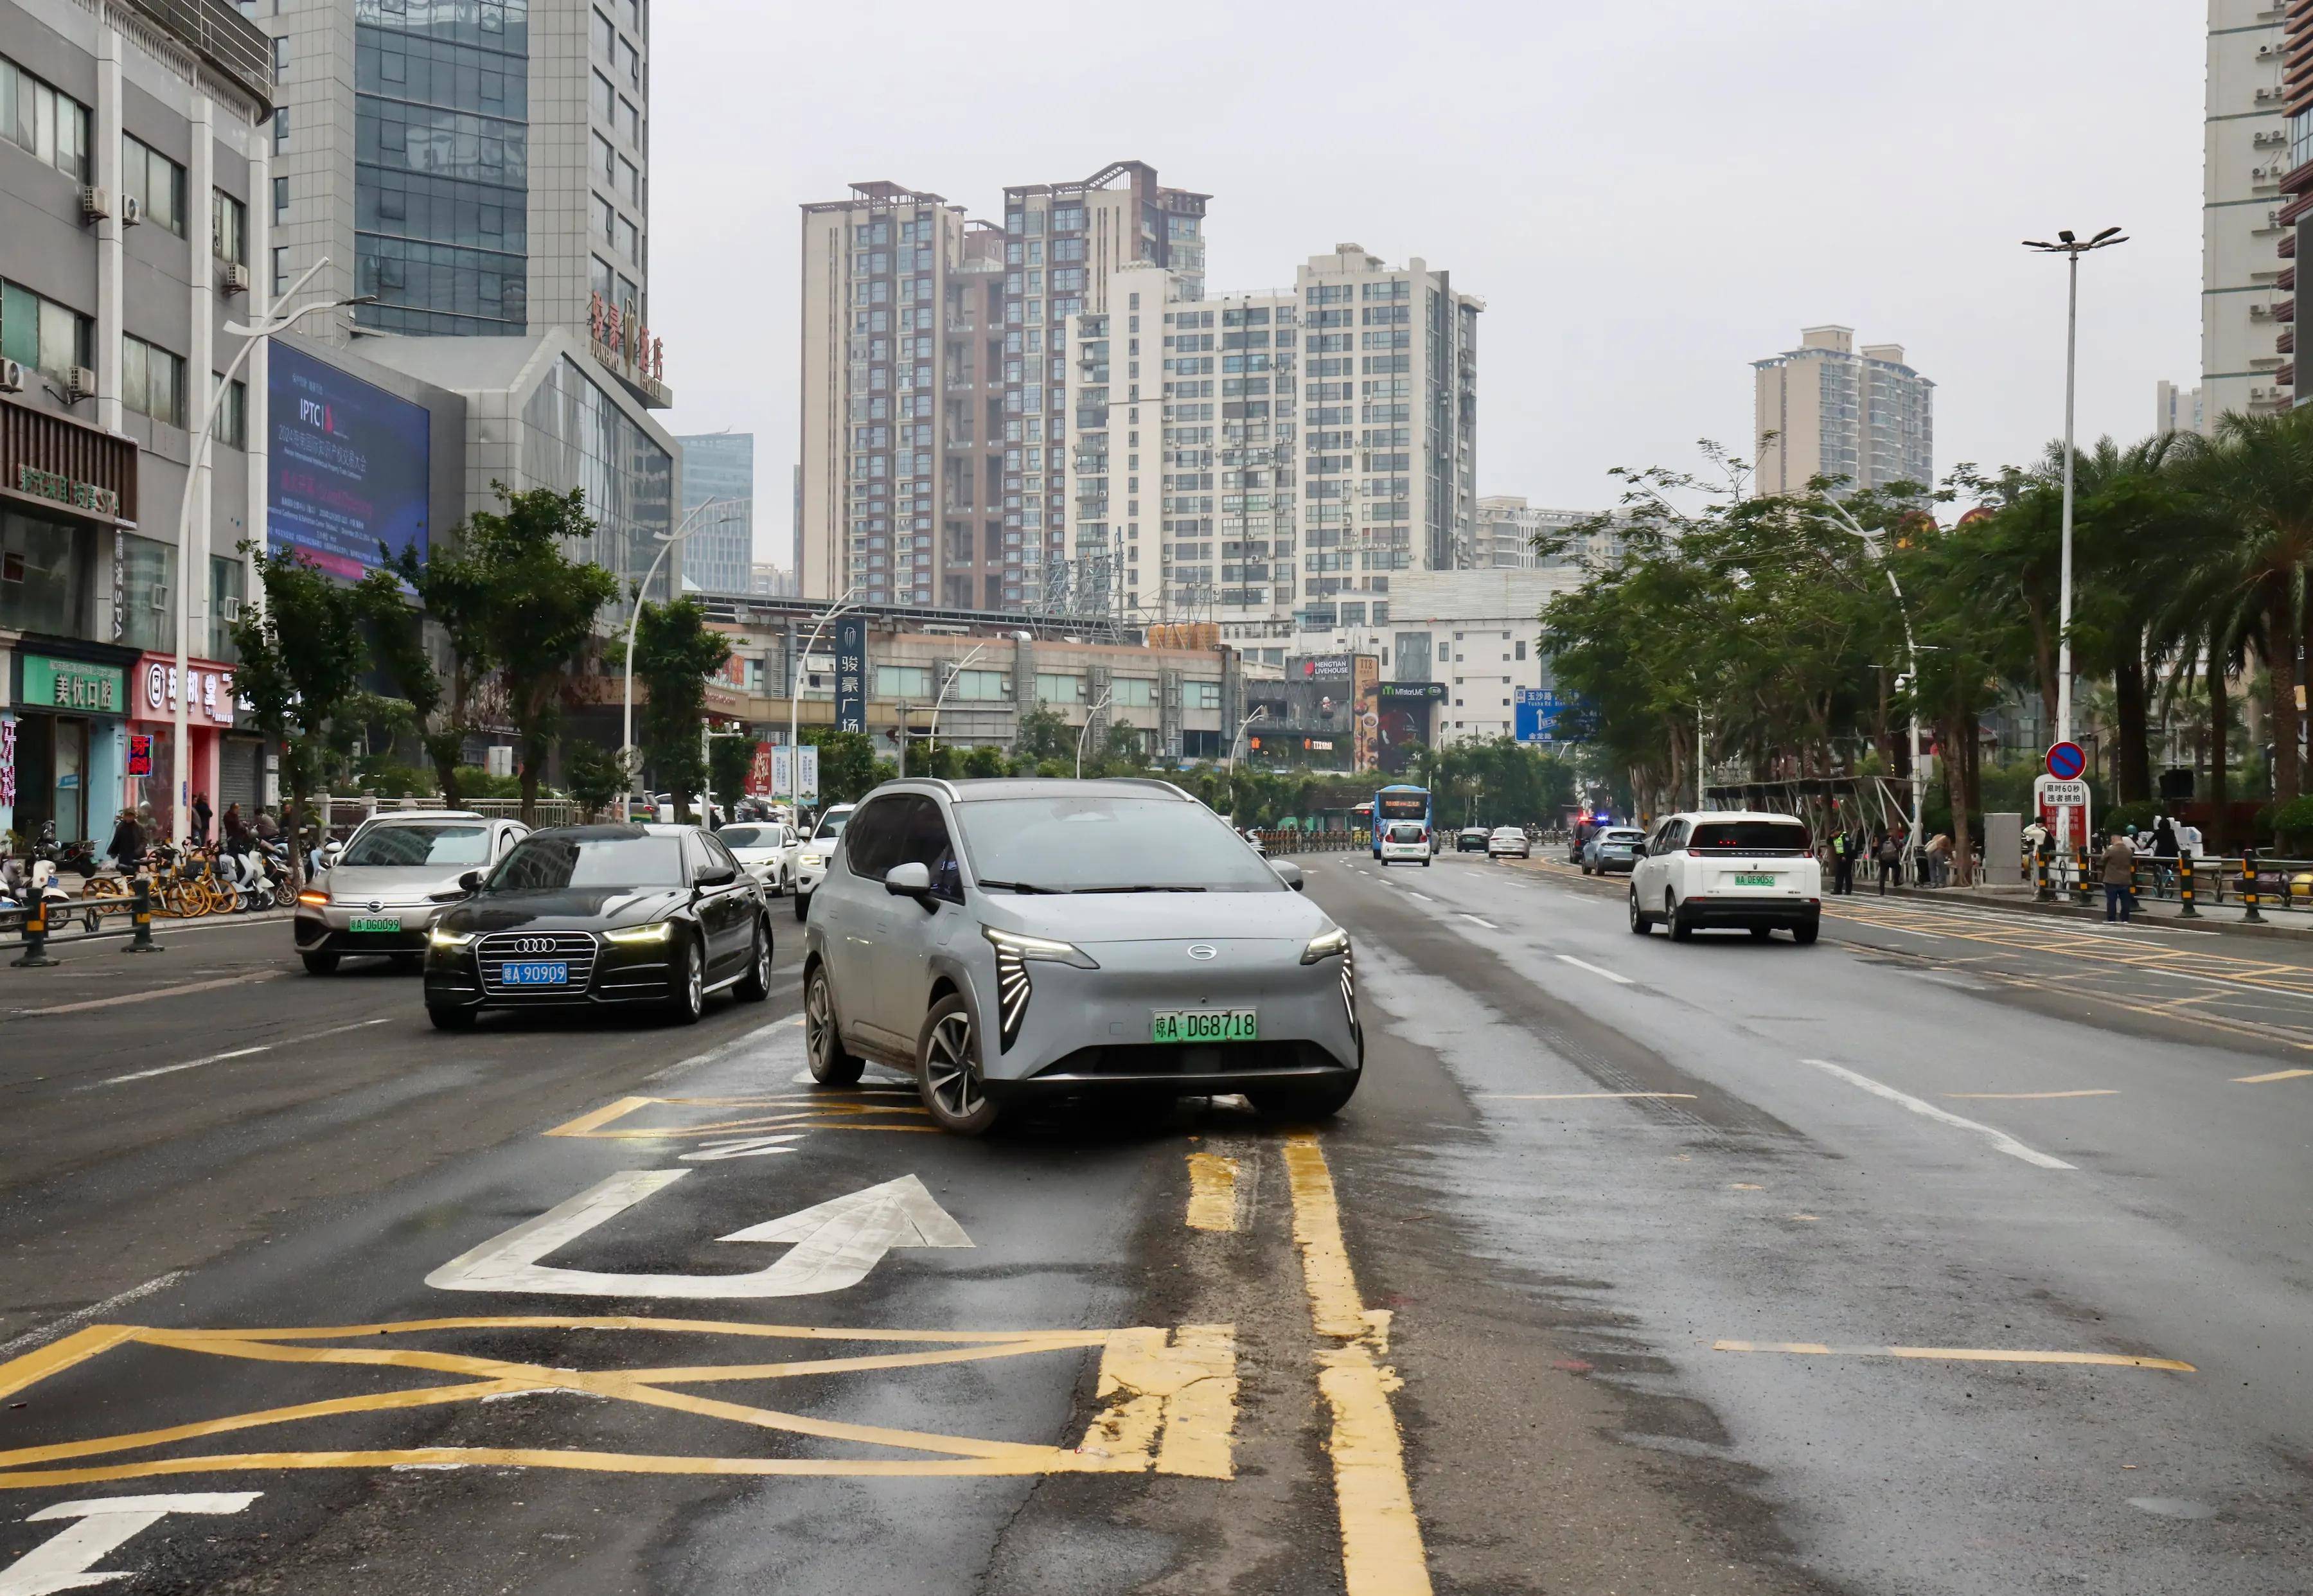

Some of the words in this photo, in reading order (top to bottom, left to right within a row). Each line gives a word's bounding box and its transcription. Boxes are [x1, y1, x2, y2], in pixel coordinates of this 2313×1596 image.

[592, 339, 619, 371] JUNHAO
[641, 373, 662, 399] HOTEL
[300, 398, 321, 427] IPTC
[55, 673, 112, 707] 美优口腔
[842, 656, 858, 734] 骏豪广场
[1527, 692, 1552, 701] 玉沙路
[130, 736, 149, 776] 牙科
[2047, 785, 2080, 793] 限时60秒
[2048, 794, 2080, 802] 违者抓拍
